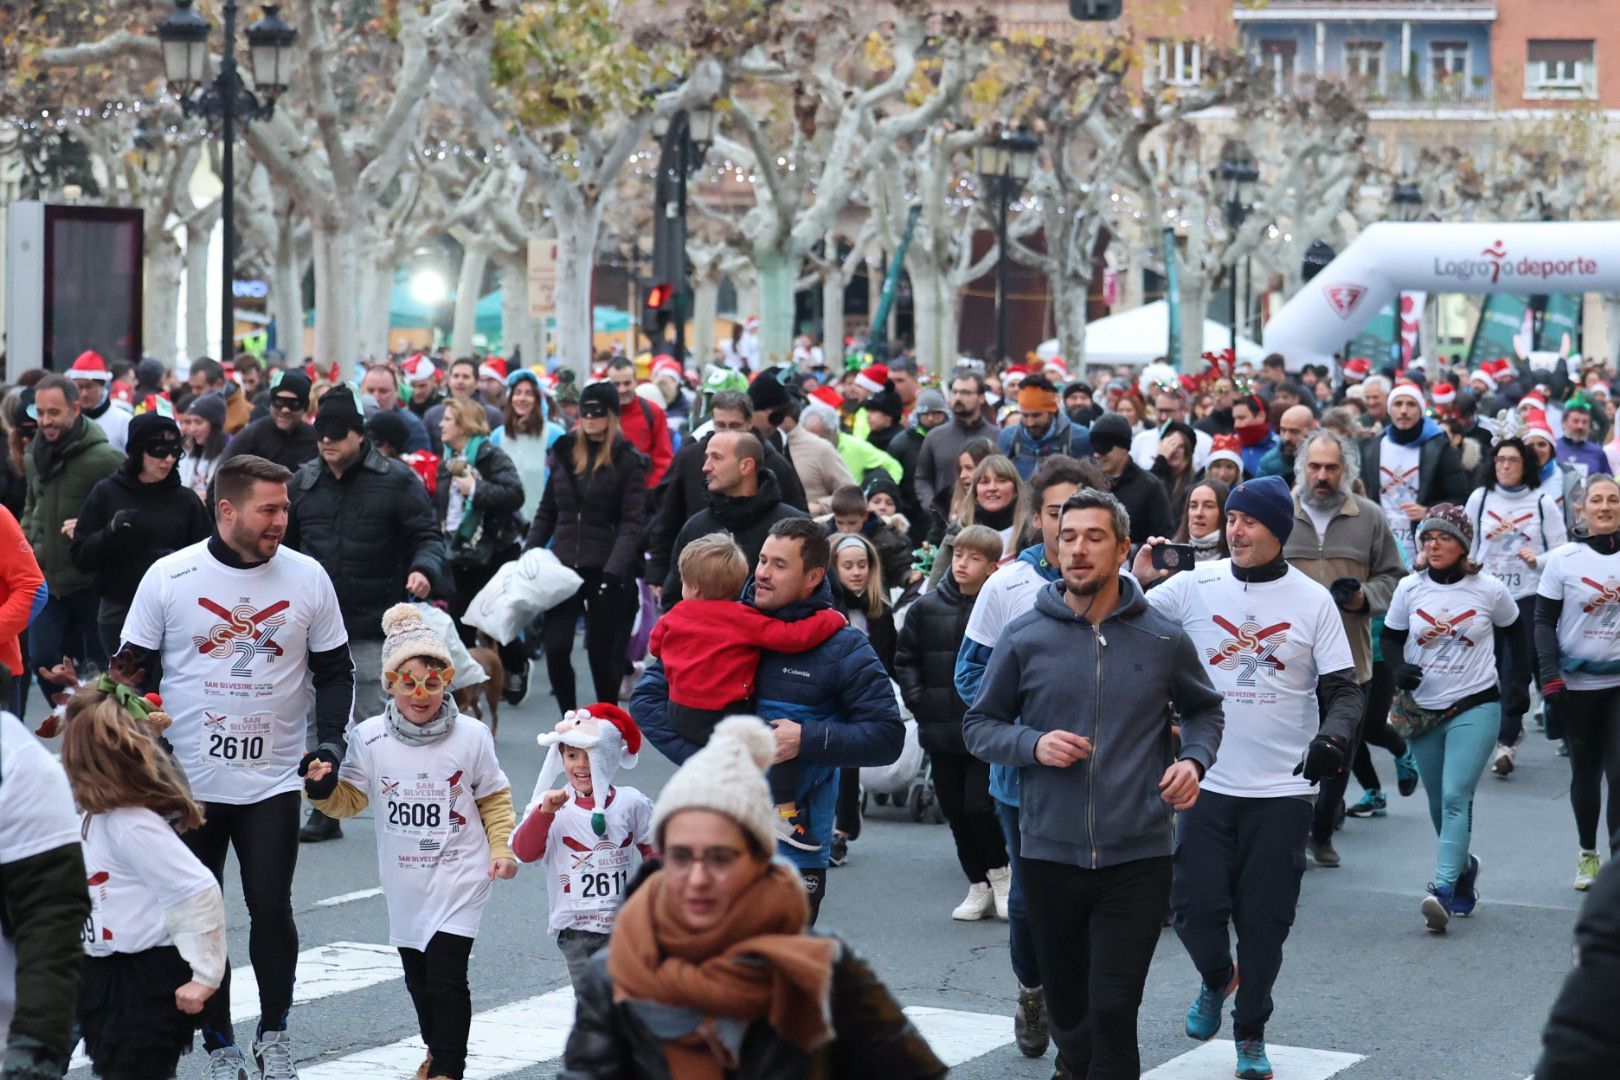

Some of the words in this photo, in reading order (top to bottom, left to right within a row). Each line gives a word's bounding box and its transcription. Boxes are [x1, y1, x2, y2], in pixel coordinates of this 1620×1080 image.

[1517, 257, 1597, 278] deporte
[787, 668, 811, 678] Columbia
[208, 734, 264, 760] 2610
[388, 800, 441, 828] 2608
[581, 869, 627, 898] 2611
